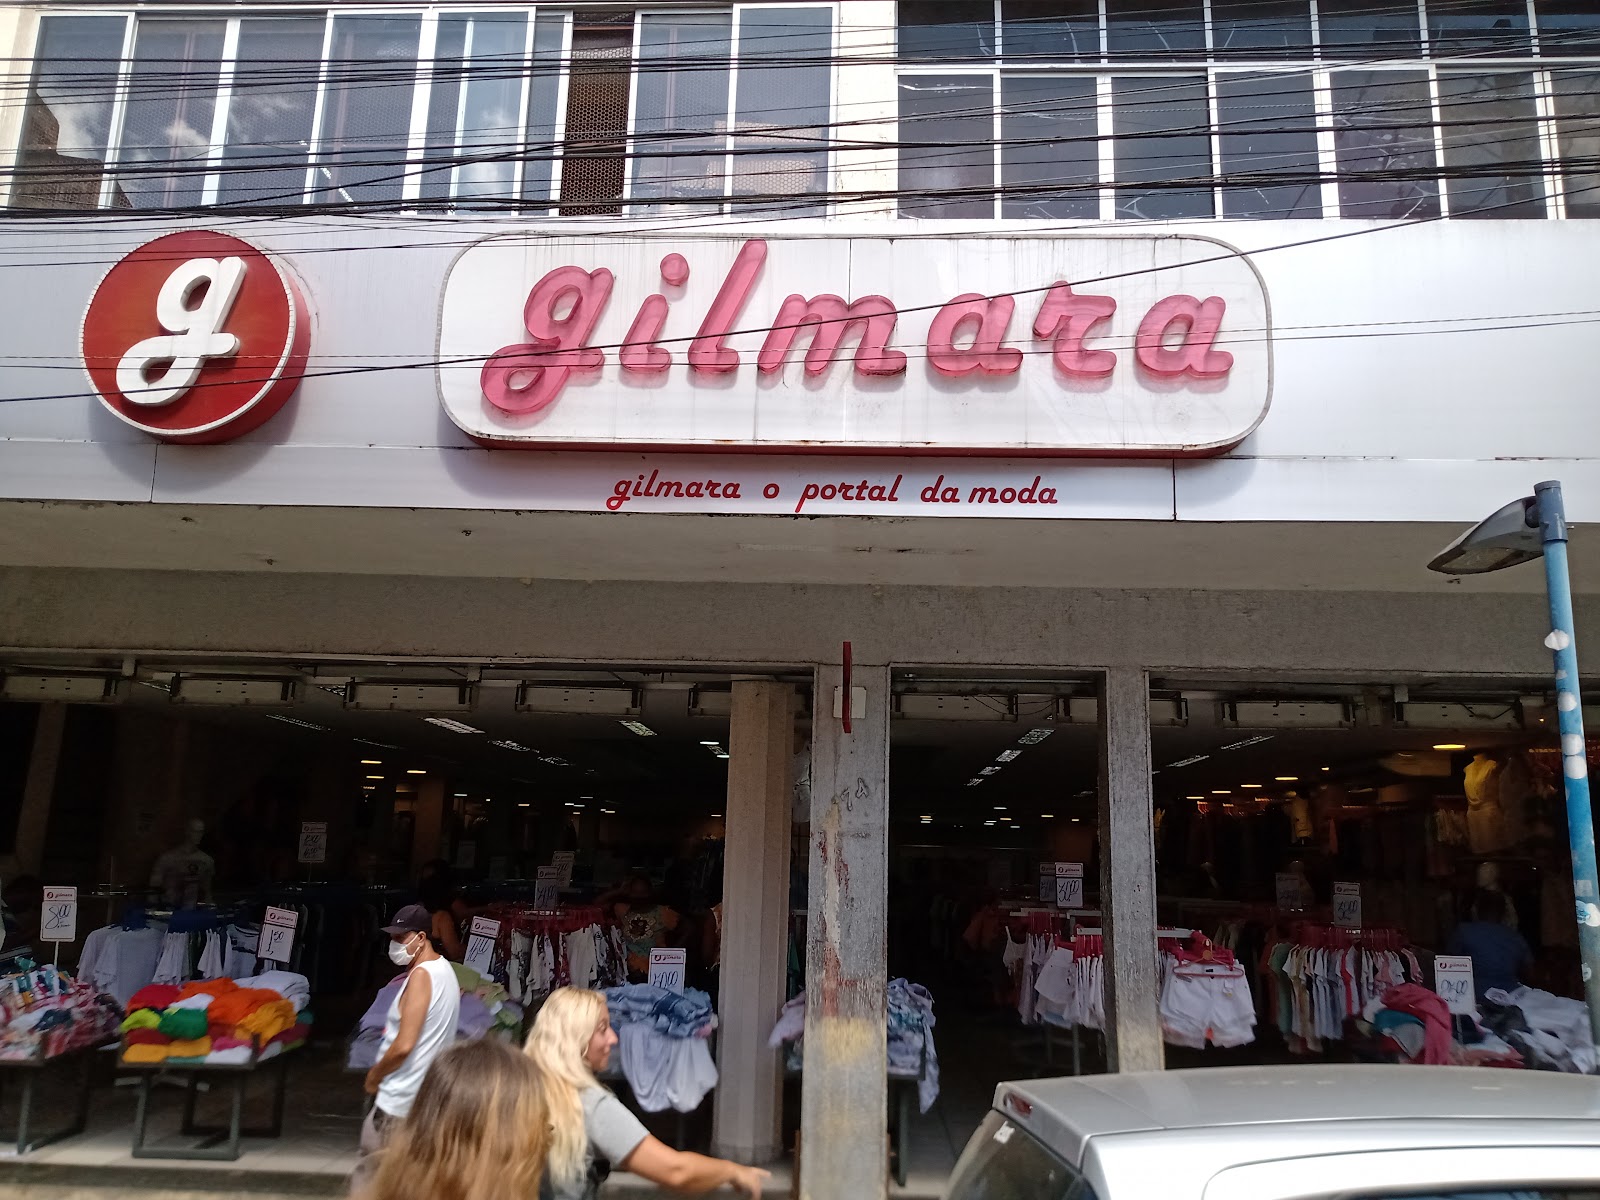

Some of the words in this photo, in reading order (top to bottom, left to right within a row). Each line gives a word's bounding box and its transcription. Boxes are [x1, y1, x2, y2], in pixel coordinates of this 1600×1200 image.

[115, 256, 248, 407] g
[480, 237, 1235, 415] gilmara
[605, 469, 742, 511] gilmara
[762, 482, 780, 499] o
[794, 474, 903, 513] portal
[920, 474, 961, 503] da
[967, 475, 1059, 504] moda
